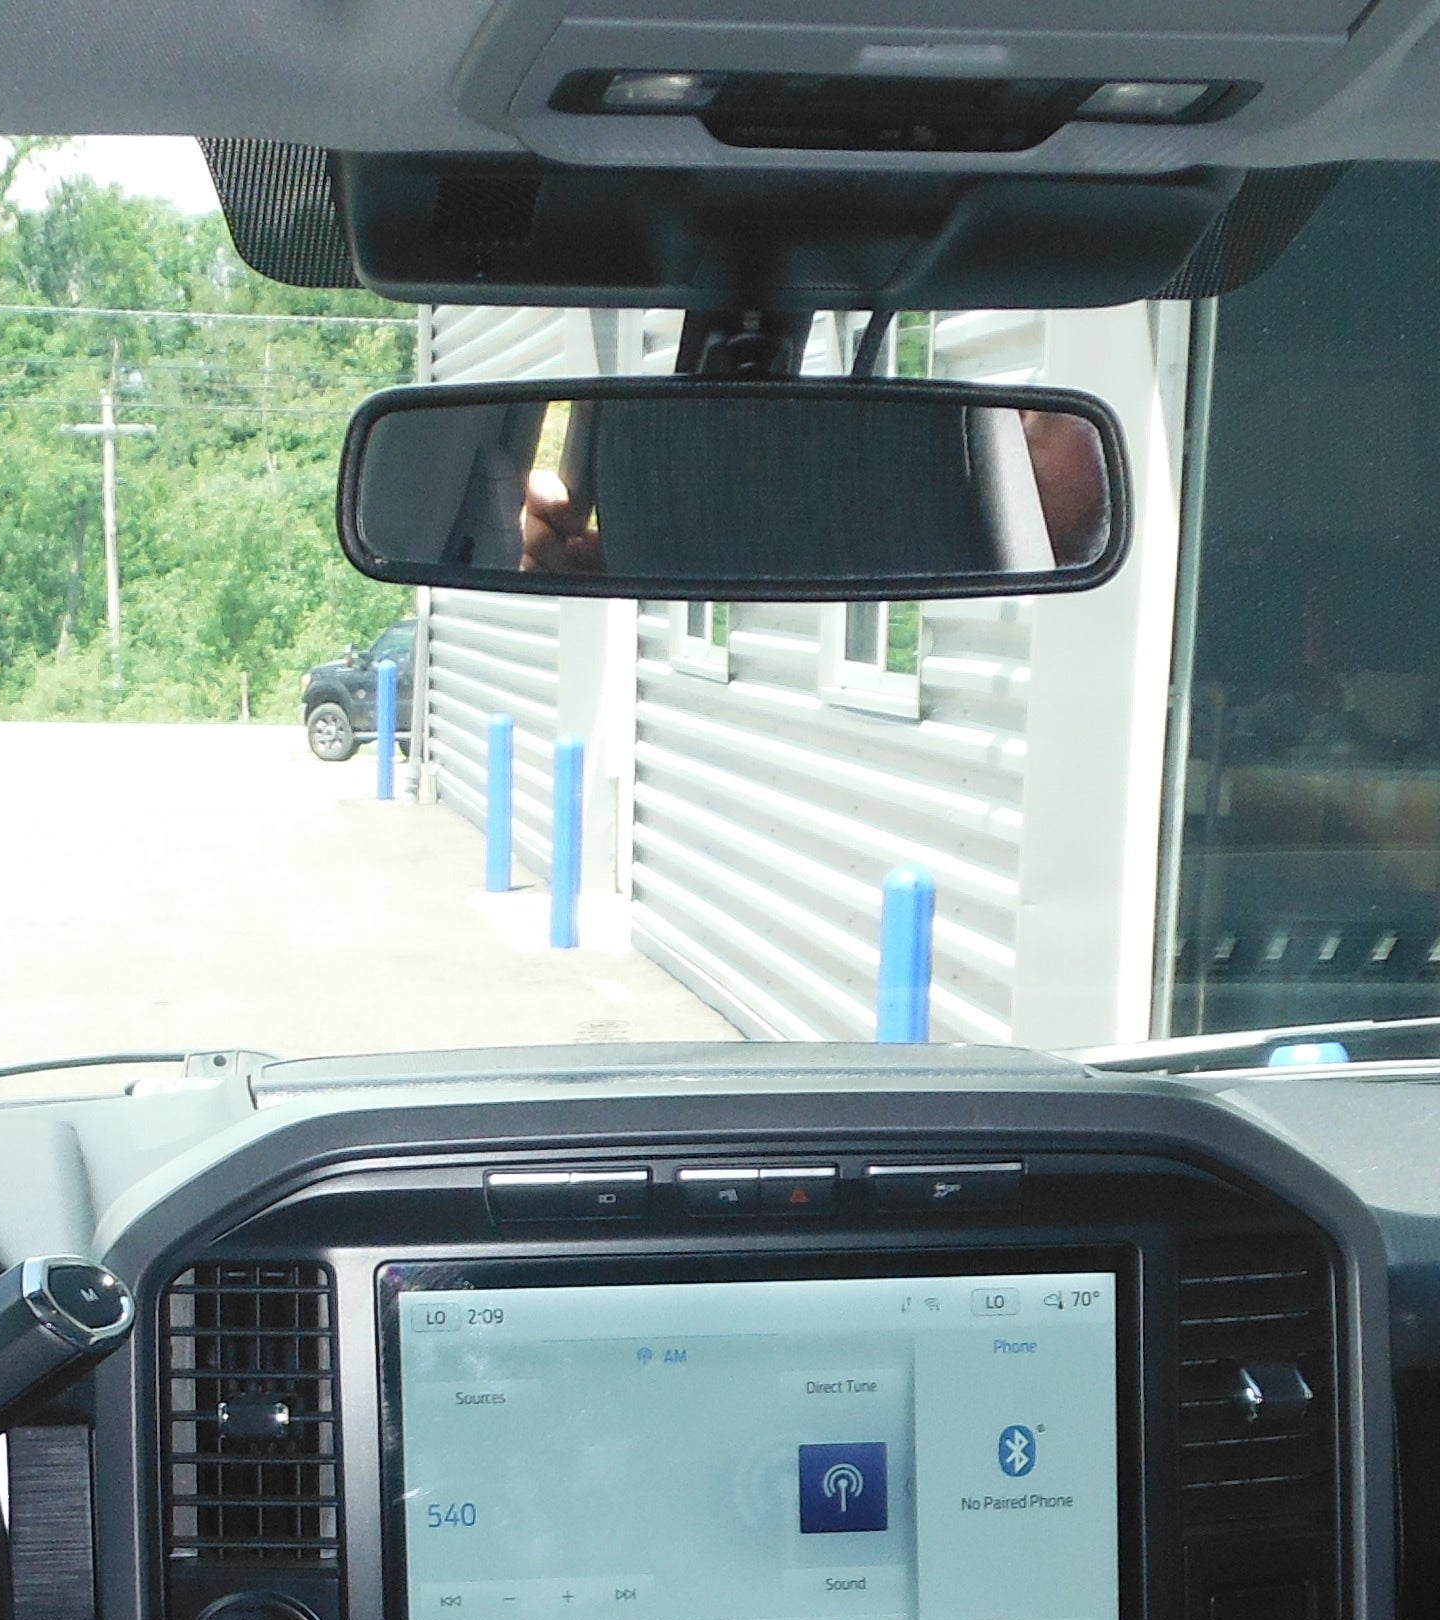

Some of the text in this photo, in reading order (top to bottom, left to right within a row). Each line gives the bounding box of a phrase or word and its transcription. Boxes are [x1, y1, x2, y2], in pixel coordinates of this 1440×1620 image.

[985, 1294, 1005, 1309] LO
[426, 1308, 505, 1325] LO 2:09
[992, 1339, 1038, 1354] Phone
[663, 1349, 688, 1364] AM
[806, 1380, 878, 1395] Direct Tune
[455, 1390, 507, 1406] Sources
[961, 1494, 1074, 1511] No Paired Phone
[427, 1502, 477, 1528] 540
[825, 1577, 867, 1592] Sound
